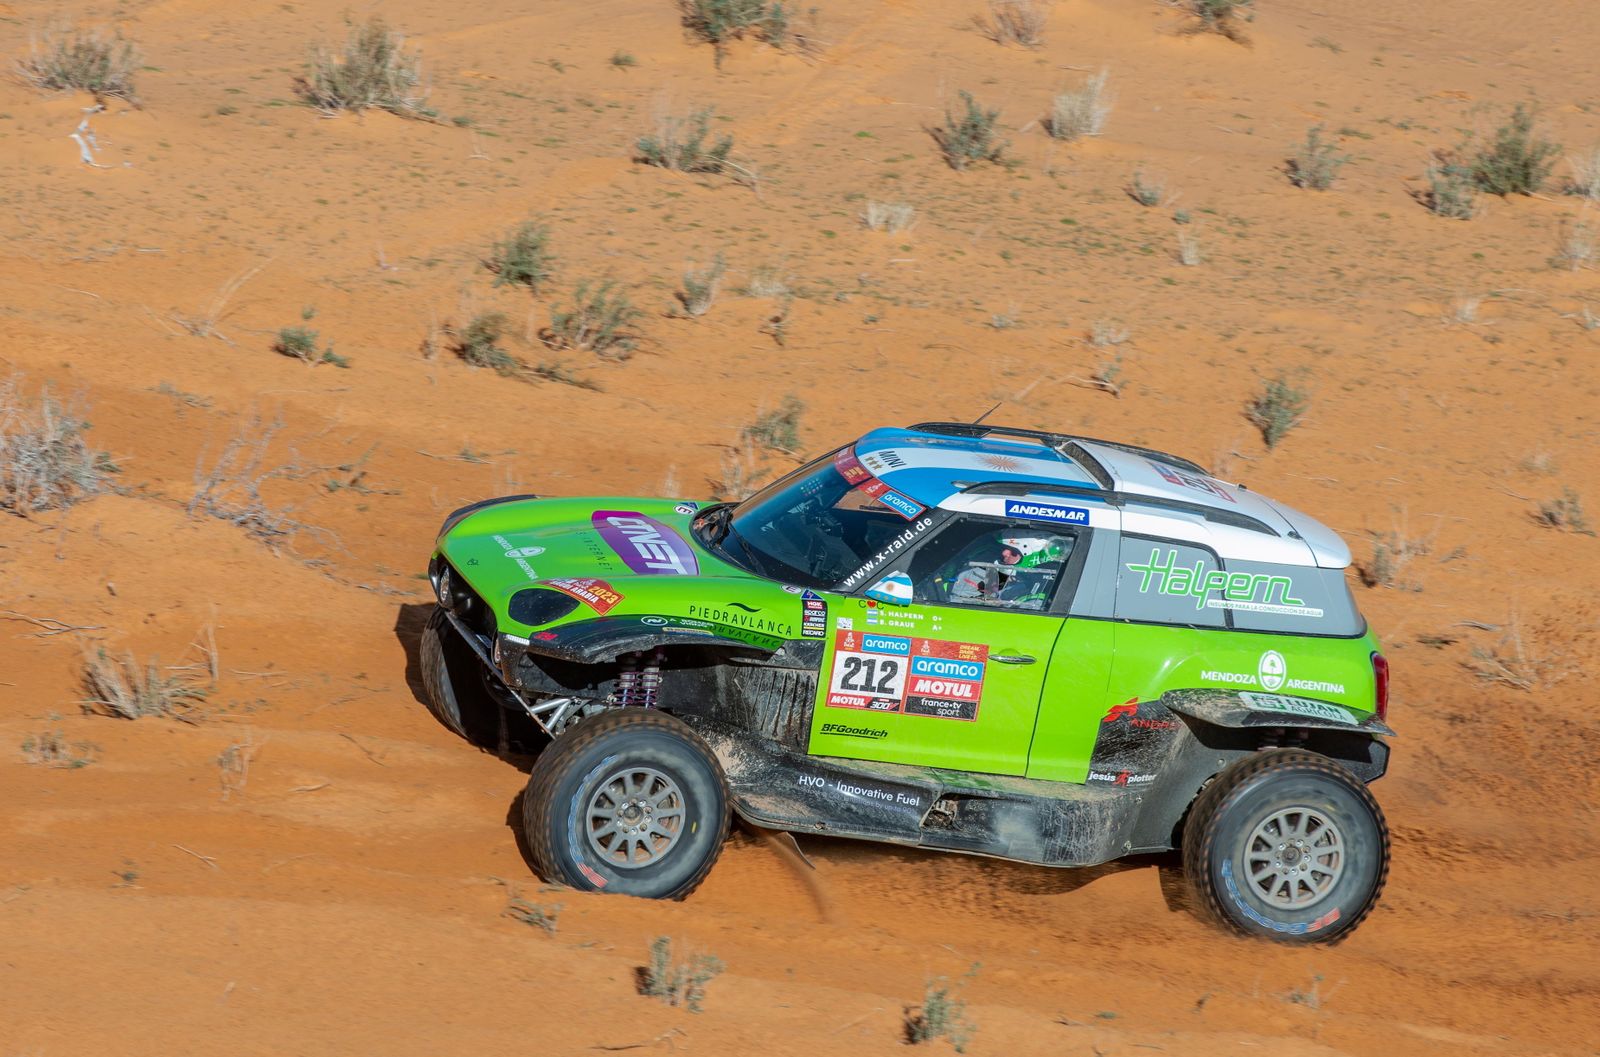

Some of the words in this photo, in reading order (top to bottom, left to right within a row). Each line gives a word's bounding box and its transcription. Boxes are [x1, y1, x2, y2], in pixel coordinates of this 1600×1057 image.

[878, 450, 907, 468] MINI
[884, 494, 917, 514] aramco
[1008, 504, 1086, 521] ANDESMAR
[843, 517, 933, 587] www.x-raid.de
[1125, 548, 1306, 610] Halpern
[569, 586, 600, 604] ARABIA
[588, 585, 619, 605] 2023
[689, 605, 793, 637] PIEDRAVLANCA
[888, 611, 924, 620] HALPERN
[888, 620, 915, 628] GRAUE
[865, 638, 908, 651] aramco
[840, 656, 899, 695] 212
[916, 660, 979, 677] aramco
[914, 679, 973, 698] MOTUL
[1200, 670, 1257, 685] MENDOZA
[1286, 678, 1345, 695] ARGENTINA
[830, 696, 866, 707] MOTUL
[936, 707, 960, 717] sport
[820, 723, 889, 738] BFGoodrich
[1127, 774, 1157, 784] plotter
[799, 775, 825, 788] HVO
[836, 781, 894, 802] Innovative
[896, 793, 920, 807] Fuel
